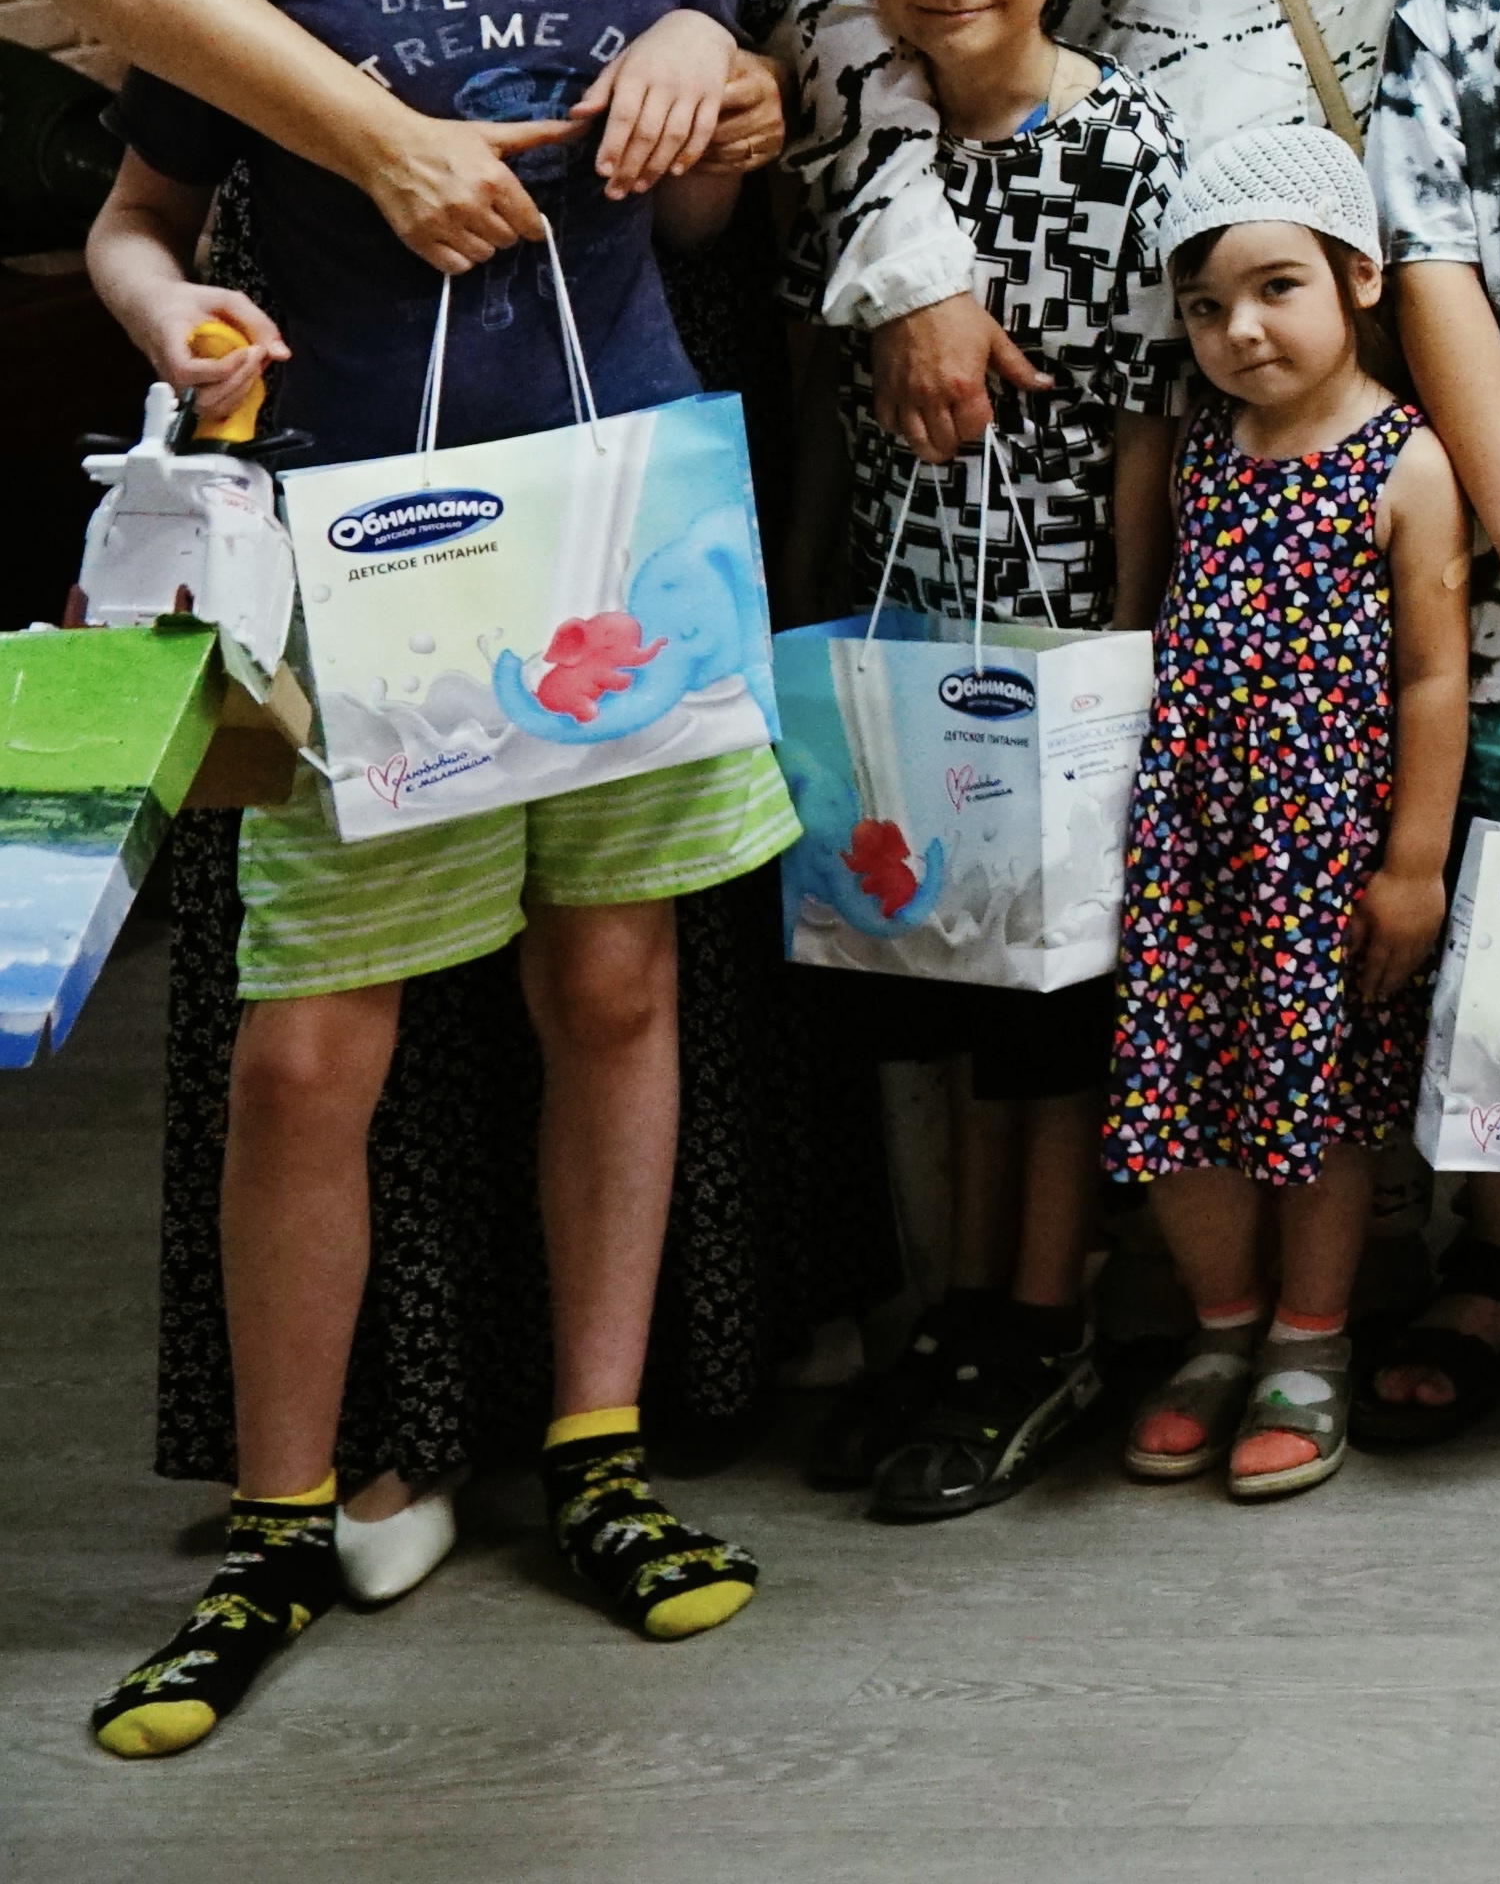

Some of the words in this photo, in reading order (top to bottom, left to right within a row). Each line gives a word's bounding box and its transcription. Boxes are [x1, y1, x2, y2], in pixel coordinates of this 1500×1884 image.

[329, 495, 500, 547] Обнимама
[346, 554, 418, 584] ДЕТСКОЕ
[422, 539, 500, 568] ПИТАНИЕ
[942, 677, 1034, 705] Обнимама
[944, 730, 985, 742] ДЕТСКОЕ
[987, 734, 1029, 748] ПИТАНИЕ
